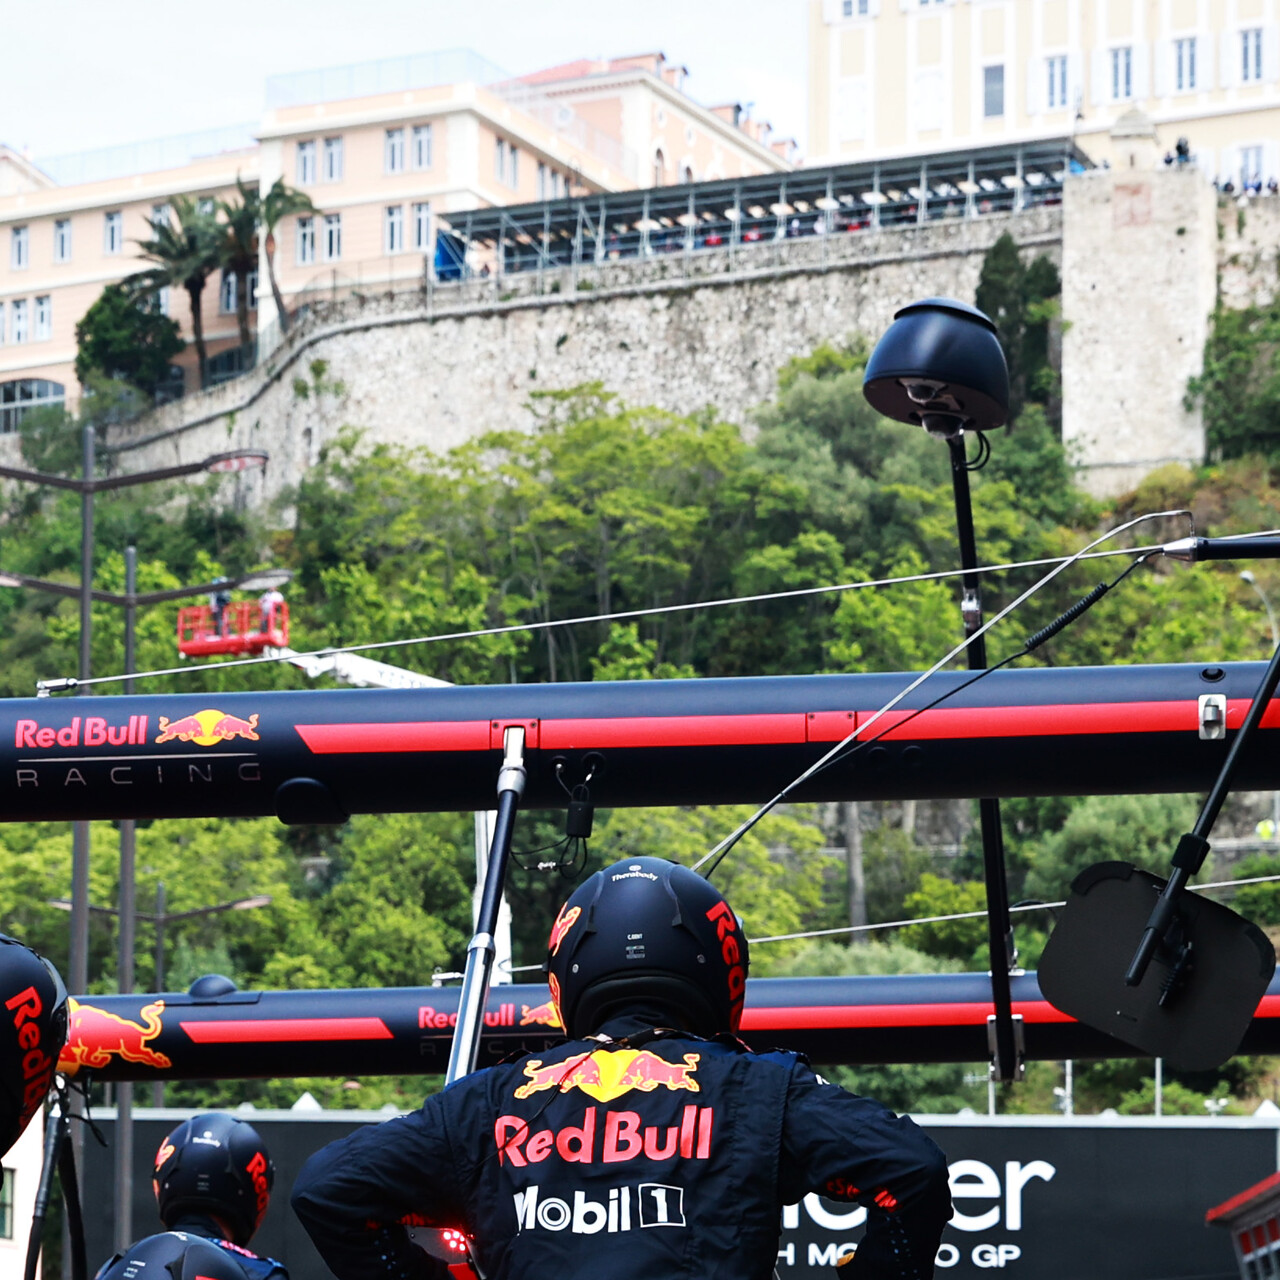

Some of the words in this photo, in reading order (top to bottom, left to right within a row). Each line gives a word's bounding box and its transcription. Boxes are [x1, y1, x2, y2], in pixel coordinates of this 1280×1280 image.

[15, 717, 81, 748] Red
[84, 715, 149, 746] Bull
[16, 762, 261, 787] RACING
[483, 1003, 516, 1027] ull
[494, 1106, 596, 1167] Red
[603, 1104, 713, 1164] Bull
[513, 1185, 631, 1234] Mobil
[971, 1243, 1021, 1268] GP
